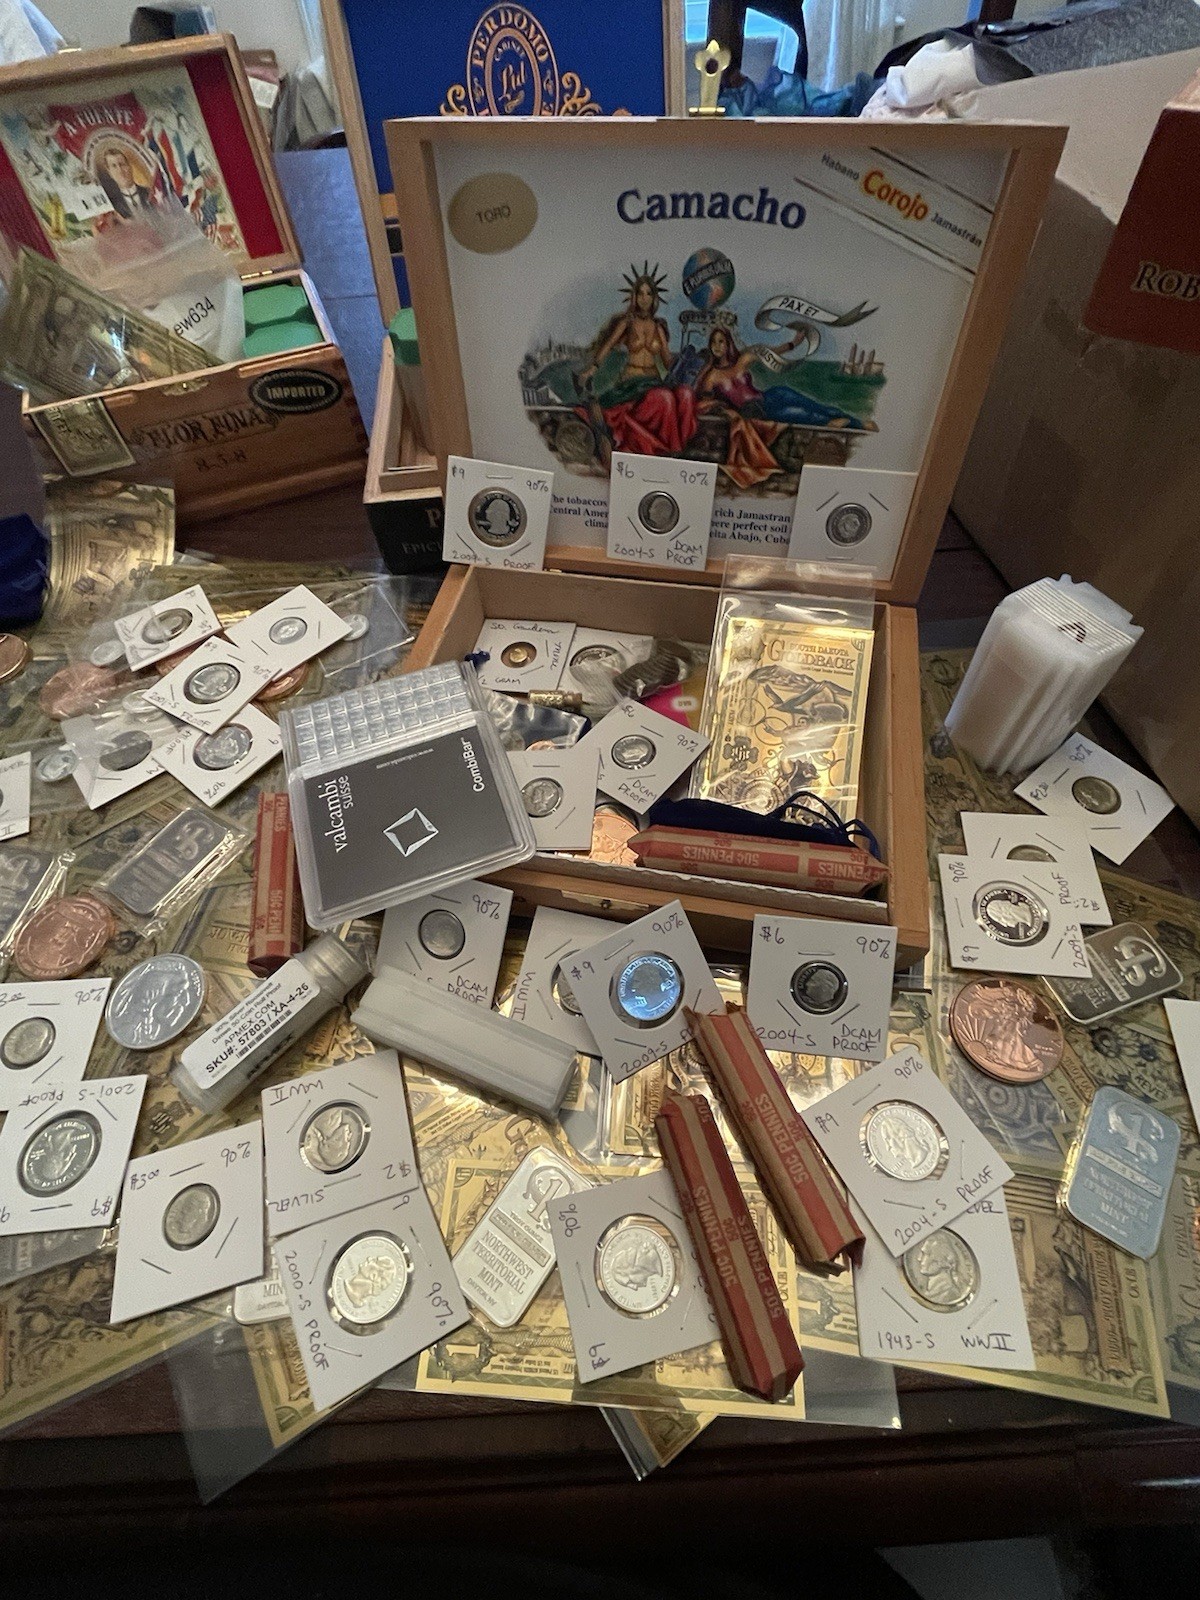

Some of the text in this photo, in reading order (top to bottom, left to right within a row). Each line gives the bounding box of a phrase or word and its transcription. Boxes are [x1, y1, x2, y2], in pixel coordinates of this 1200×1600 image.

[472, 8, 549, 68] PERDOMO
[616, 186, 807, 230] Camacho
[821, 153, 983, 249] Habano Corojo Jamastrán
[475, 206, 512, 223] TORO
[173, 296, 216, 337] ew634
[780, 297, 820, 317] PAX ET
[267, 385, 327, 400] IMPORTED
[451, 465, 549, 493] $9 90%
[616, 461, 709, 486] $6 90%
[551, 494, 609, 507] he tobaccos
[583, 507, 609, 518] Amer
[714, 508, 791, 523] rich Jamastran
[732, 521, 768, 532] perfect
[770, 525, 788, 533] soil
[401, 540, 442, 554] EPIC
[614, 539, 704, 559] 2004-S DCAM
[729, 531, 762, 543] Abajo,
[503, 558, 536, 570] PROOF
[665, 549, 699, 566] PROOF
[766, 638, 857, 671] GOLDBACK
[790, 643, 849, 657] SOUTH DAKOTA
[494, 676, 521, 685] GRAM
[180, 710, 212, 728] PROOF
[676, 733, 699, 754] 90%
[203, 780, 227, 800] 90%
[337, 774, 354, 809] suisse
[618, 782, 650, 805] PROOF
[632, 778, 658, 801] DCAM
[273, 793, 288, 833] PENNIES
[317, 780, 348, 854] valcambi
[682, 846, 760, 867] 50¢ PENNIES
[818, 861, 871, 882] PENNIES
[948, 861, 969, 883] 90%
[472, 893, 501, 921] 90%
[1051, 871, 1087, 969] PROOF 2009-S
[571, 911, 684, 981] $9 90%
[758, 925, 891, 960] $6 90%
[75, 986, 107, 1006] 90%
[447, 982, 486, 1005] PROOF
[456, 975, 488, 995] DCAM
[206, 1044, 239, 1073] SKU#:
[238, 1018, 267, 1046] 57803
[271, 982, 310, 1017] XA-4-26
[224, 1000, 276, 1046] APMEX.COM
[753, 1024, 882, 1048] 2004-S DCAM
[832, 1034, 880, 1052] PROOF
[620, 1040, 669, 1075] 2009-S
[19, 1083, 136, 1107] 2001-S PROOF
[270, 1079, 324, 1106] WWII
[814, 1055, 924, 1135] 90% $9
[755, 1091, 810, 1186] 50¢ PENNIES
[221, 1141, 252, 1168] 90%
[956, 1165, 995, 1203] PROOF
[90, 1198, 113, 1217] $9
[524, 1223, 545, 1243] OUNCE
[692, 1184, 740, 1288] 50¢ PENNIES
[721, 1217, 740, 1242] 50¢
[481, 1229, 535, 1279] NORTHWEST
[736, 1213, 784, 1320] 50¢ PENNIES
[472, 1240, 525, 1295] TERRITORIAL
[477, 1266, 504, 1294] MINT
[559, 1202, 611, 1370] 90% $9
[779, 1271, 790, 1301] ONE
[283, 1250, 331, 1372] 2000-S PROOF
[425, 1280, 454, 1328] 90%
[877, 1330, 1017, 1353] 1943-S WWII
